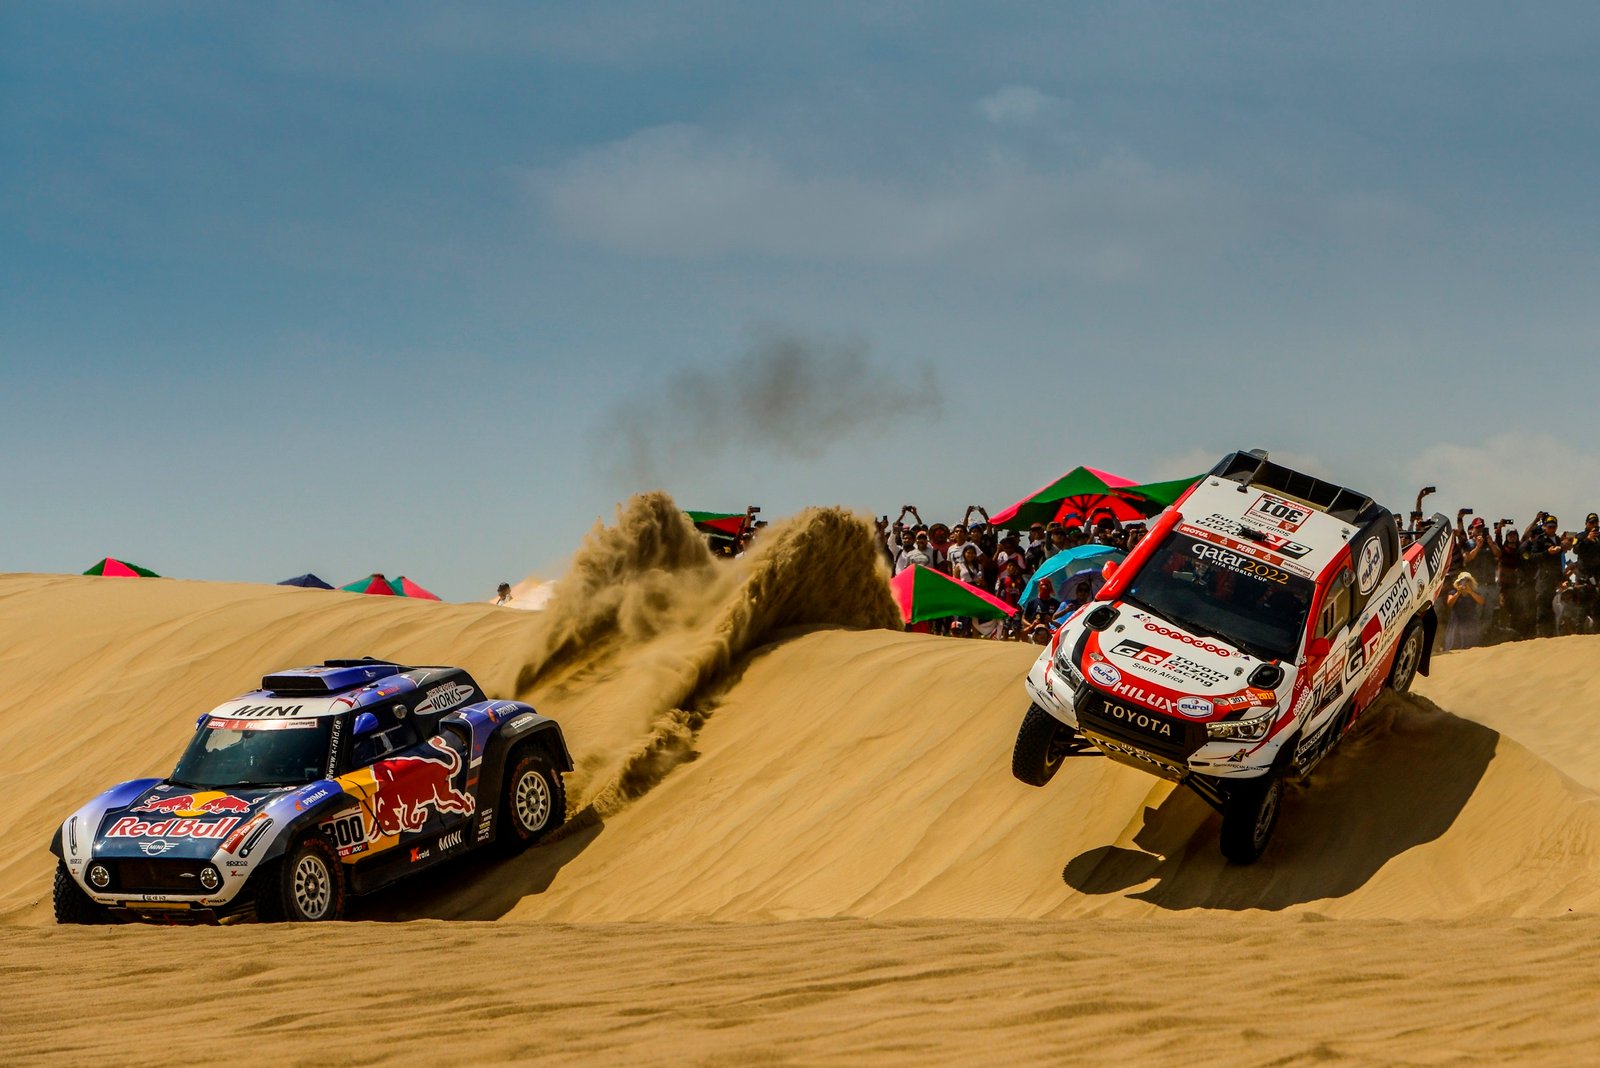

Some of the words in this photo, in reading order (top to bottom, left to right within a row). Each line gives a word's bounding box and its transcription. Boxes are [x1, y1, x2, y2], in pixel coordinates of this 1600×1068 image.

[1260, 499, 1304, 523] 301
[1181, 526, 1209, 538] MOTUL
[1430, 526, 1449, 573] HILUX
[1191, 543, 1247, 567] qatar
[1243, 561, 1289, 584] 2022
[1212, 559, 1226, 569] FIFA
[1228, 564, 1252, 577] WORLD
[1254, 573, 1268, 583] CUP
[1379, 572, 1406, 617] TOYOTA
[1384, 587, 1409, 630] GAZOO
[1144, 623, 1231, 658] ooredoo
[1109, 643, 1168, 666] GR
[1092, 665, 1118, 682] eurol
[1132, 662, 1159, 678] South
[1159, 670, 1184, 684] Africa
[1162, 663, 1214, 687] Racing
[1168, 659, 1221, 683] GAZOO
[1174, 655, 1229, 680] TOYOTA
[429, 688, 462, 711] WORKS
[1112, 681, 1179, 714] HILUX
[1180, 702, 1210, 713] eurol
[1230, 696, 1245, 704] 301
[231, 705, 303, 717] MINI
[497, 703, 519, 718] PRIMAX
[1103, 700, 1171, 736] TOYOTA
[1091, 735, 1182, 774] TOYOTA
[302, 789, 329, 806] PRIMAX
[104, 817, 177, 838] Red
[166, 818, 242, 839] Bull
[320, 815, 365, 847] 300
[438, 830, 462, 852] MINI
